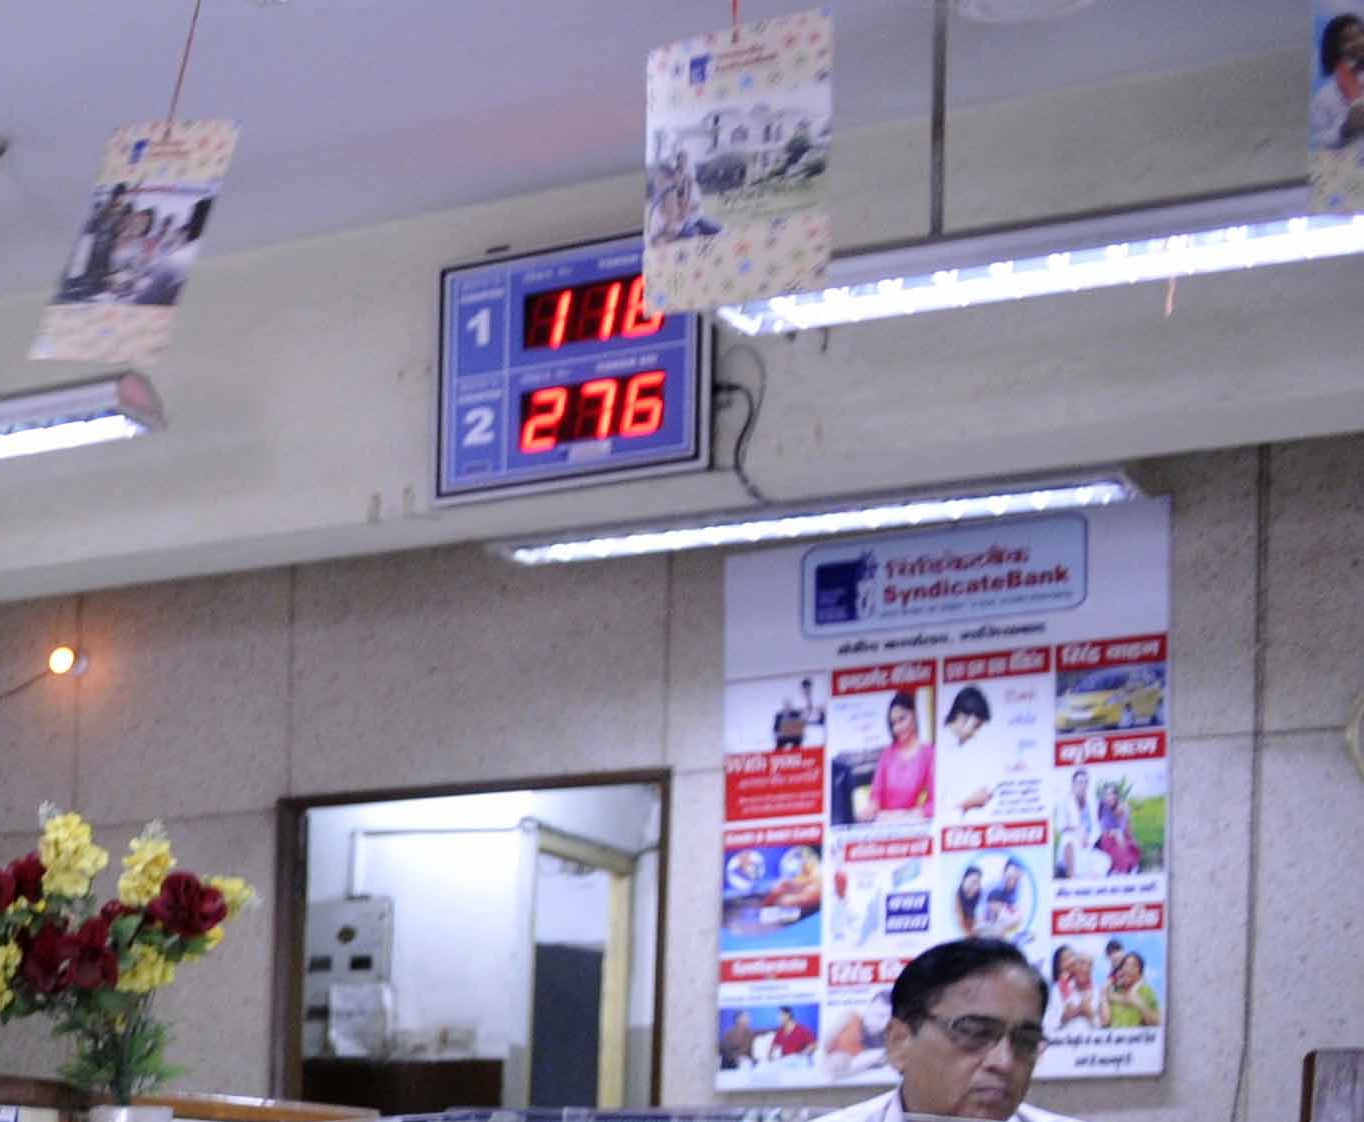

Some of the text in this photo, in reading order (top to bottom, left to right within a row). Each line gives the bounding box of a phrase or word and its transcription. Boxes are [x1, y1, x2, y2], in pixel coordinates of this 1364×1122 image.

[467, 307, 491, 348] 1
[462, 406, 495, 447] 2
[520, 370, 666, 455] 276
[882, 564, 1070, 606] SyndicateBank
